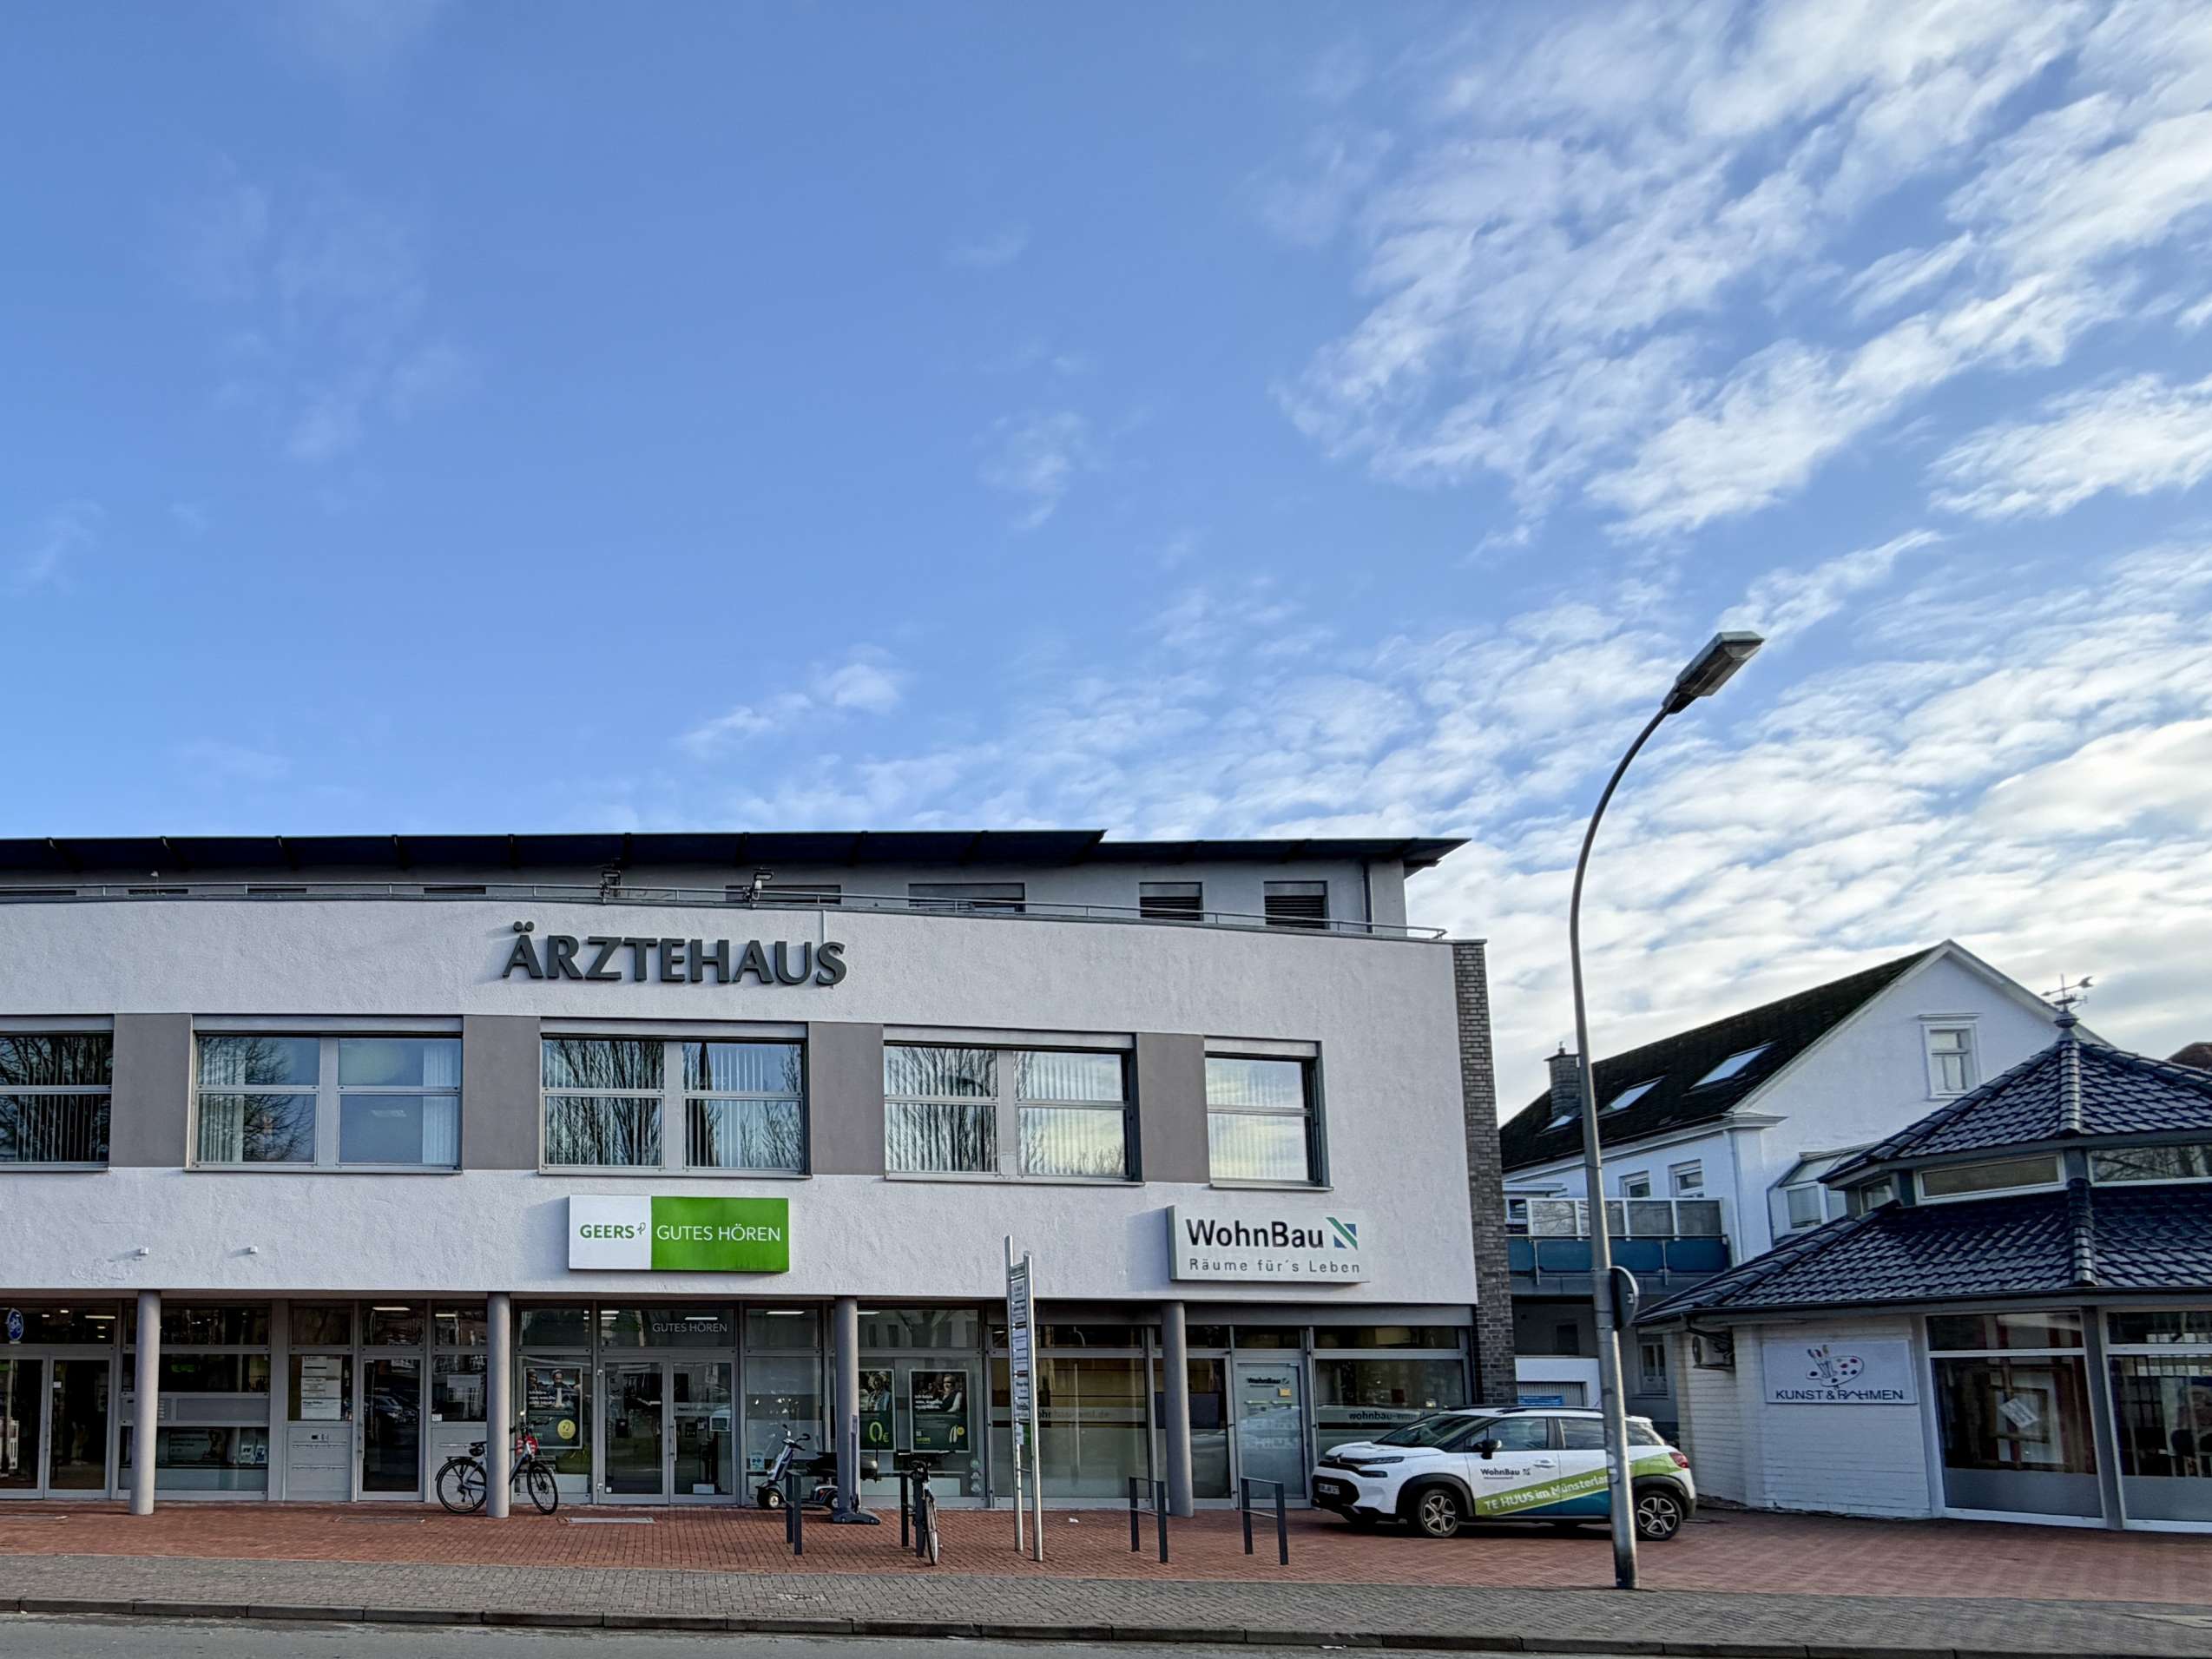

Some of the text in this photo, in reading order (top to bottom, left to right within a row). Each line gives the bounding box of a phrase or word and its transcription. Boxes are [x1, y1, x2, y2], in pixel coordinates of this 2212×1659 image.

[502, 920, 847, 986] ÄRZTEHAUS
[580, 1224, 635, 1239] GEERS
[656, 1223, 781, 1242] GUTES HÖREN
[1186, 1218, 1325, 1248] WohnBau
[1189, 1258, 1248, 1272] Räume
[1309, 1261, 1360, 1274] Leben
[652, 1321, 727, 1333] GUTES HÖREN
[1775, 1390, 1904, 1400] KUNST & RAHMEN
[1480, 1467, 1520, 1476] WohnBau
[1485, 1475, 1608, 1511] TE HUUS im Münsterlan
